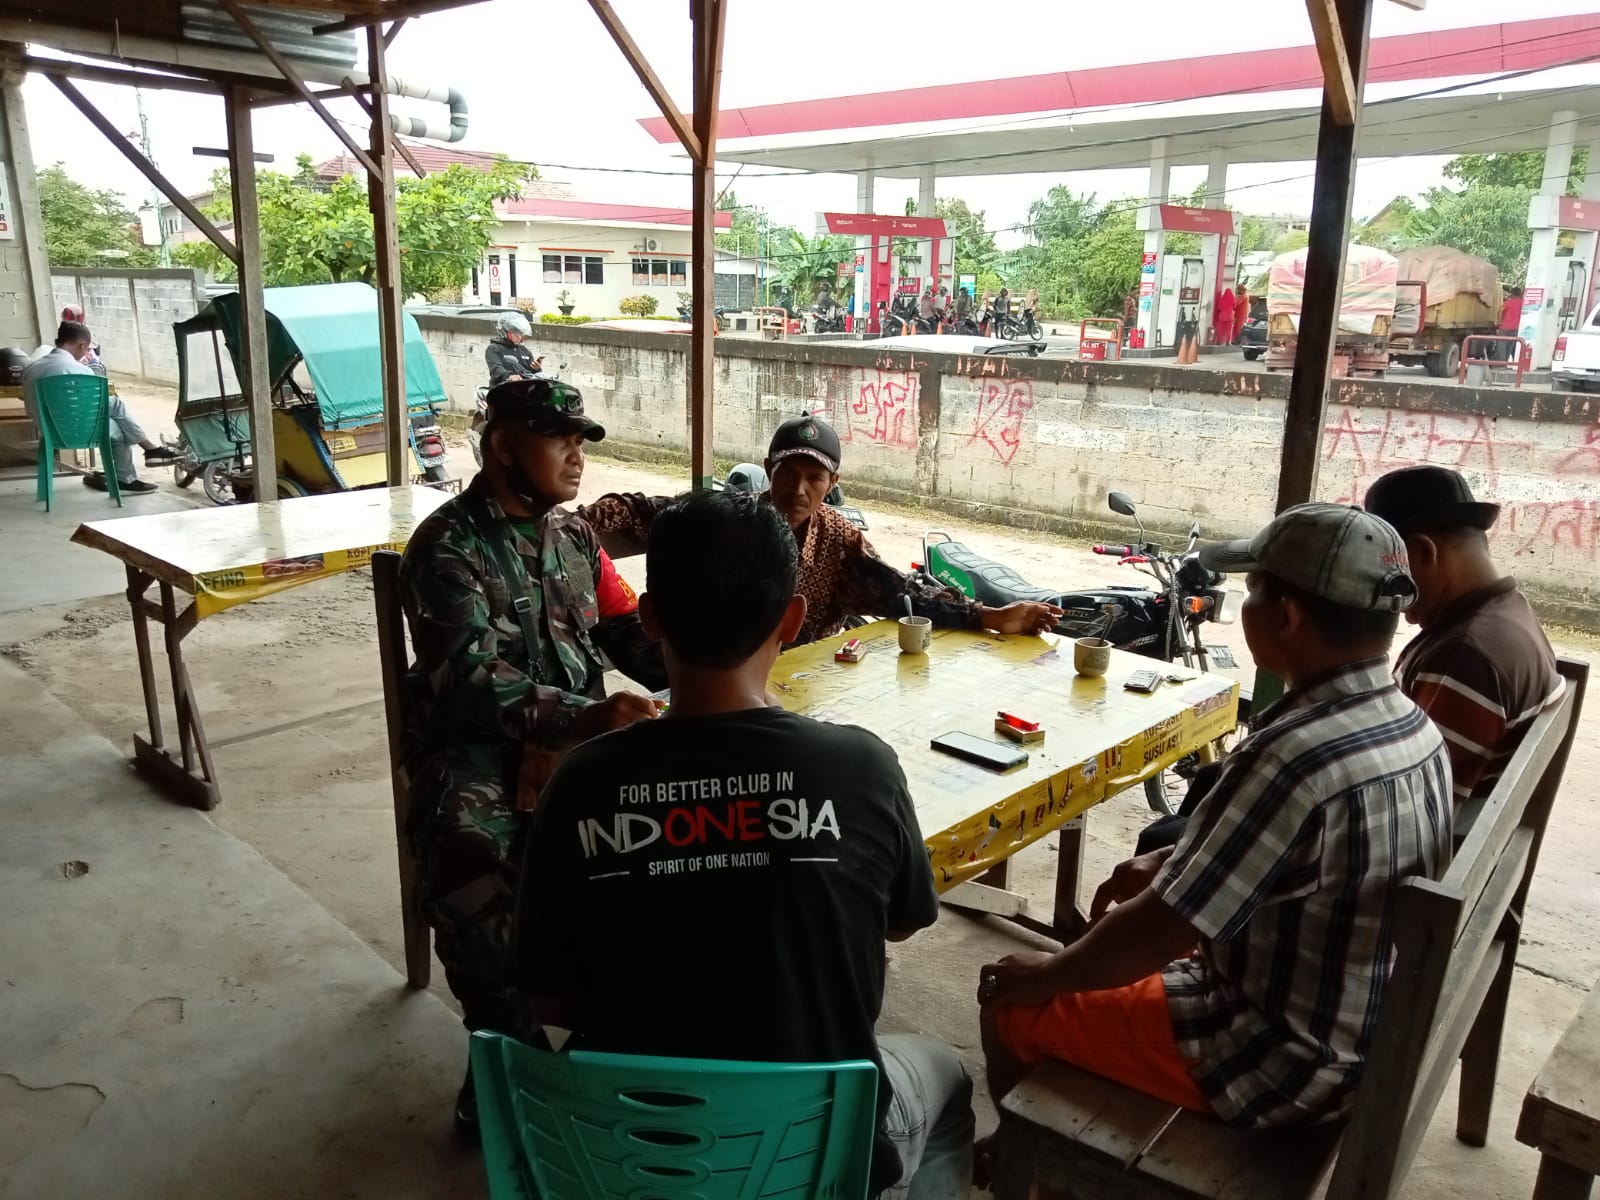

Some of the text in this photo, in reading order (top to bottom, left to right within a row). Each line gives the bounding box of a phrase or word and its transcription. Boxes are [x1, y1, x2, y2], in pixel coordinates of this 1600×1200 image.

[347, 546, 370, 558] KOPI
[1144, 741, 1165, 765] SUSU
[619, 771, 794, 805] FOR BETTER CLUB IN
[578, 798, 841, 859] INDONESIA
[648, 852, 770, 876] SPIRIT OF ONE NATION
